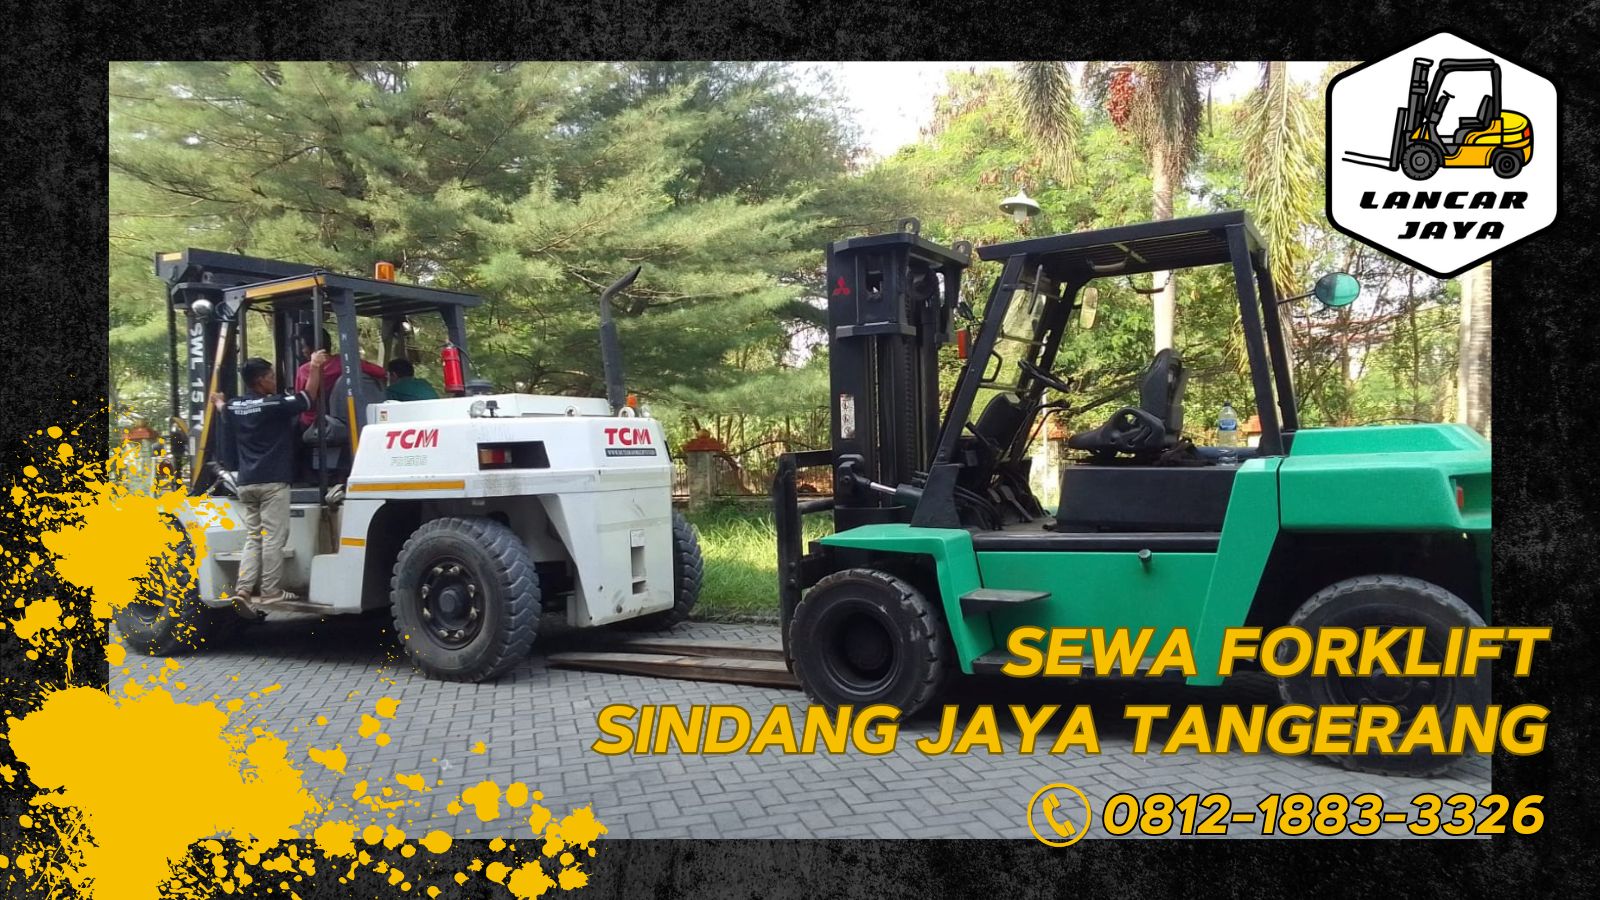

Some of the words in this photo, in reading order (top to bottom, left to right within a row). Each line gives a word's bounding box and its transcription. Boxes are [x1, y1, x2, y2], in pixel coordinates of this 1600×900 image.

[190, 322, 204, 370] SWL
[191, 377, 205, 403] 15
[386, 429, 439, 449] TCM
[604, 427, 652, 446] TCM
